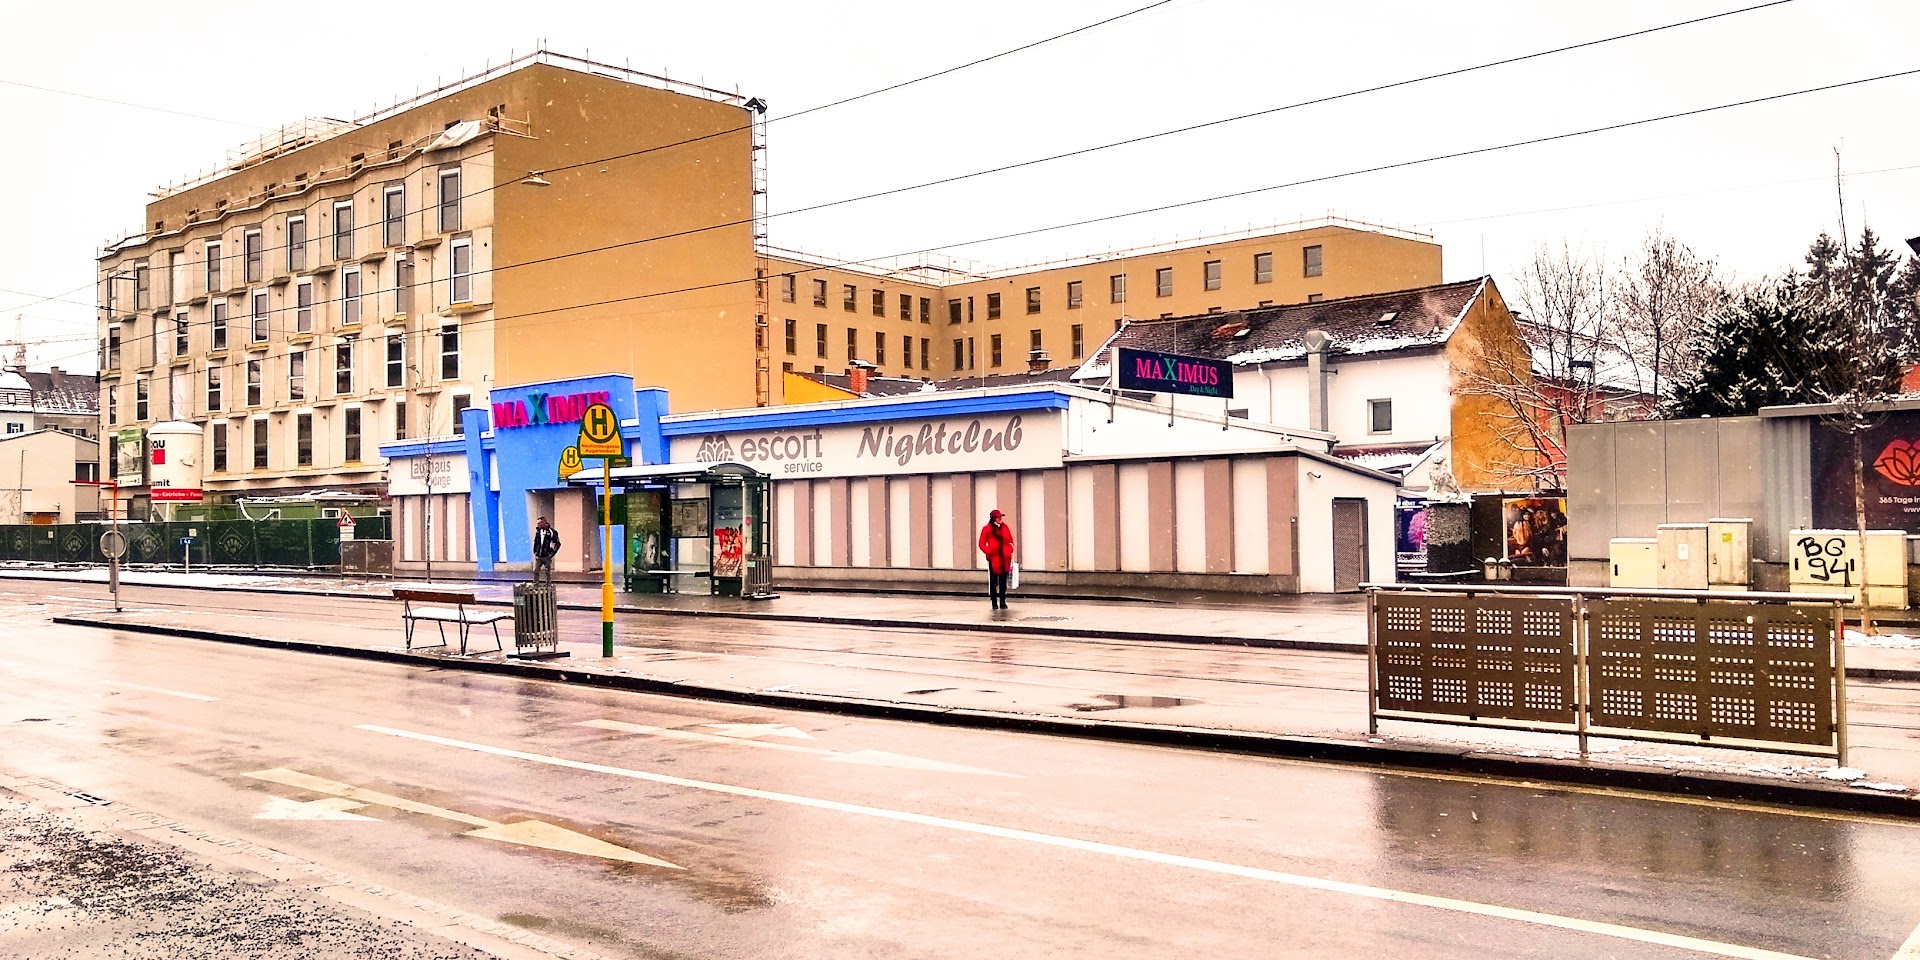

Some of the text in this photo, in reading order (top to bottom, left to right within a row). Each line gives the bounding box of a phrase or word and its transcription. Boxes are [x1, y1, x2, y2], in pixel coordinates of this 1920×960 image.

[1136, 358, 1218, 385] MAXIMUS
[1205, 386, 1218, 395] Night
[591, 409, 607, 435] H
[741, 428, 822, 462] escort
[856, 415, 1023, 466] Nightclub
[567, 450, 575, 464] H
[784, 459, 823, 473] service
